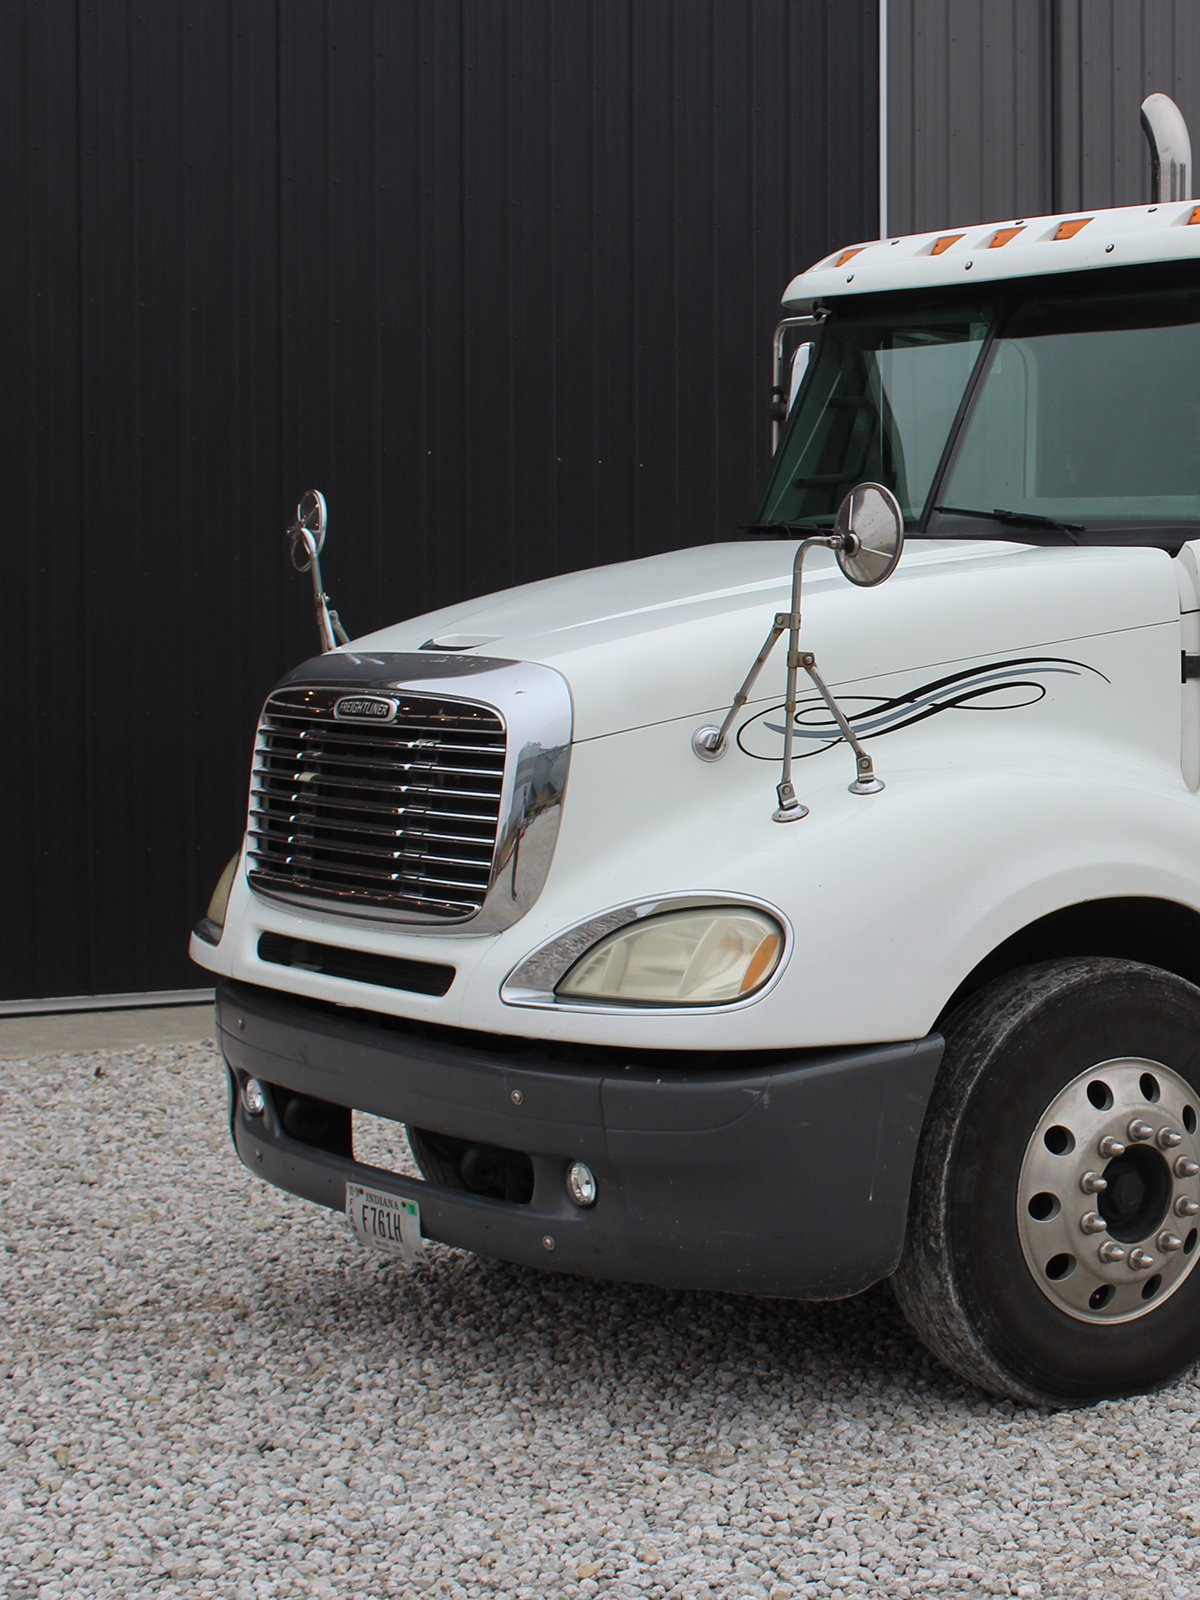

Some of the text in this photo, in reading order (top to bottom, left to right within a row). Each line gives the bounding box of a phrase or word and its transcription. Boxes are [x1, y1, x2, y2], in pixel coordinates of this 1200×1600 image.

[339, 701, 389, 715] FREIGHTLINER
[366, 1192, 399, 1211] INDIANA
[362, 1204, 403, 1244] F761H
